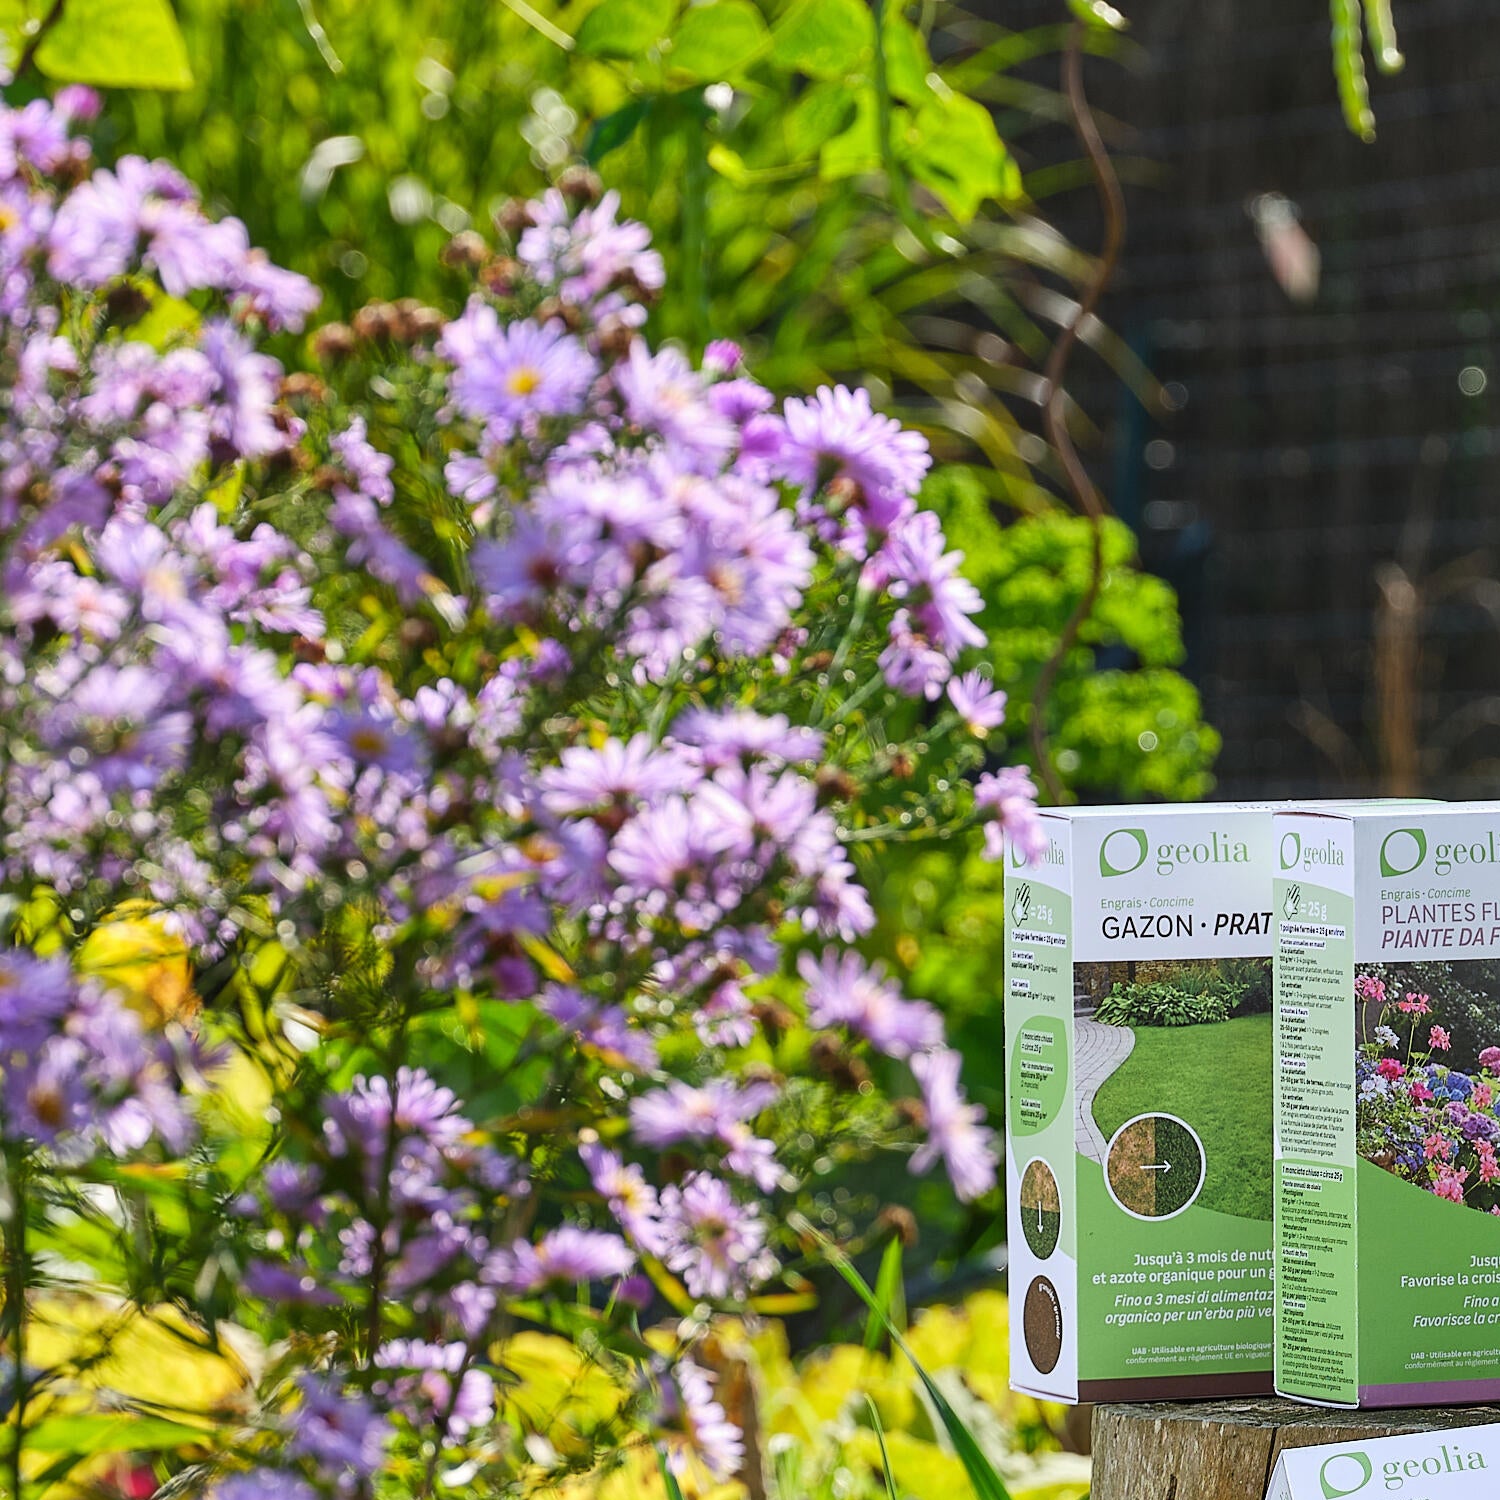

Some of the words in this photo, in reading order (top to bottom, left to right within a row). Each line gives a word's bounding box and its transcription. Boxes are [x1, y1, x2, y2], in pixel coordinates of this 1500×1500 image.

[1157, 831, 1249, 875] geolia
[1303, 841, 1343, 871] geolia
[1101, 897, 1141, 910] Engrais
[1149, 896, 1193, 907] Concime
[1381, 888, 1419, 901] Engrais
[1427, 887, 1470, 898] Concime
[1382, 903, 1474, 924] PLANTES
[1102, 914, 1191, 938] GAZON
[1381, 928, 1454, 948] PIANTE
[1459, 927, 1483, 945] DA
[1092, 1272, 1106, 1284] et
[1109, 1271, 1146, 1283] azote
[1149, 1269, 1214, 1284] organique
[1217, 1269, 1246, 1281] pour
[1250, 1268, 1265, 1277] un
[1401, 1273, 1454, 1287] Favorise
[1458, 1273, 1467, 1284] la
[1114, 1294, 1141, 1306] Fino
[1144, 1296, 1152, 1305] a
[1154, 1293, 1162, 1304] 3
[1165, 1291, 1195, 1304] mesi
[1197, 1290, 1209, 1303] di
[1413, 1313, 1470, 1326] Favorisce
[1473, 1312, 1484, 1324] la
[1383, 1445, 1487, 1490] geolia
